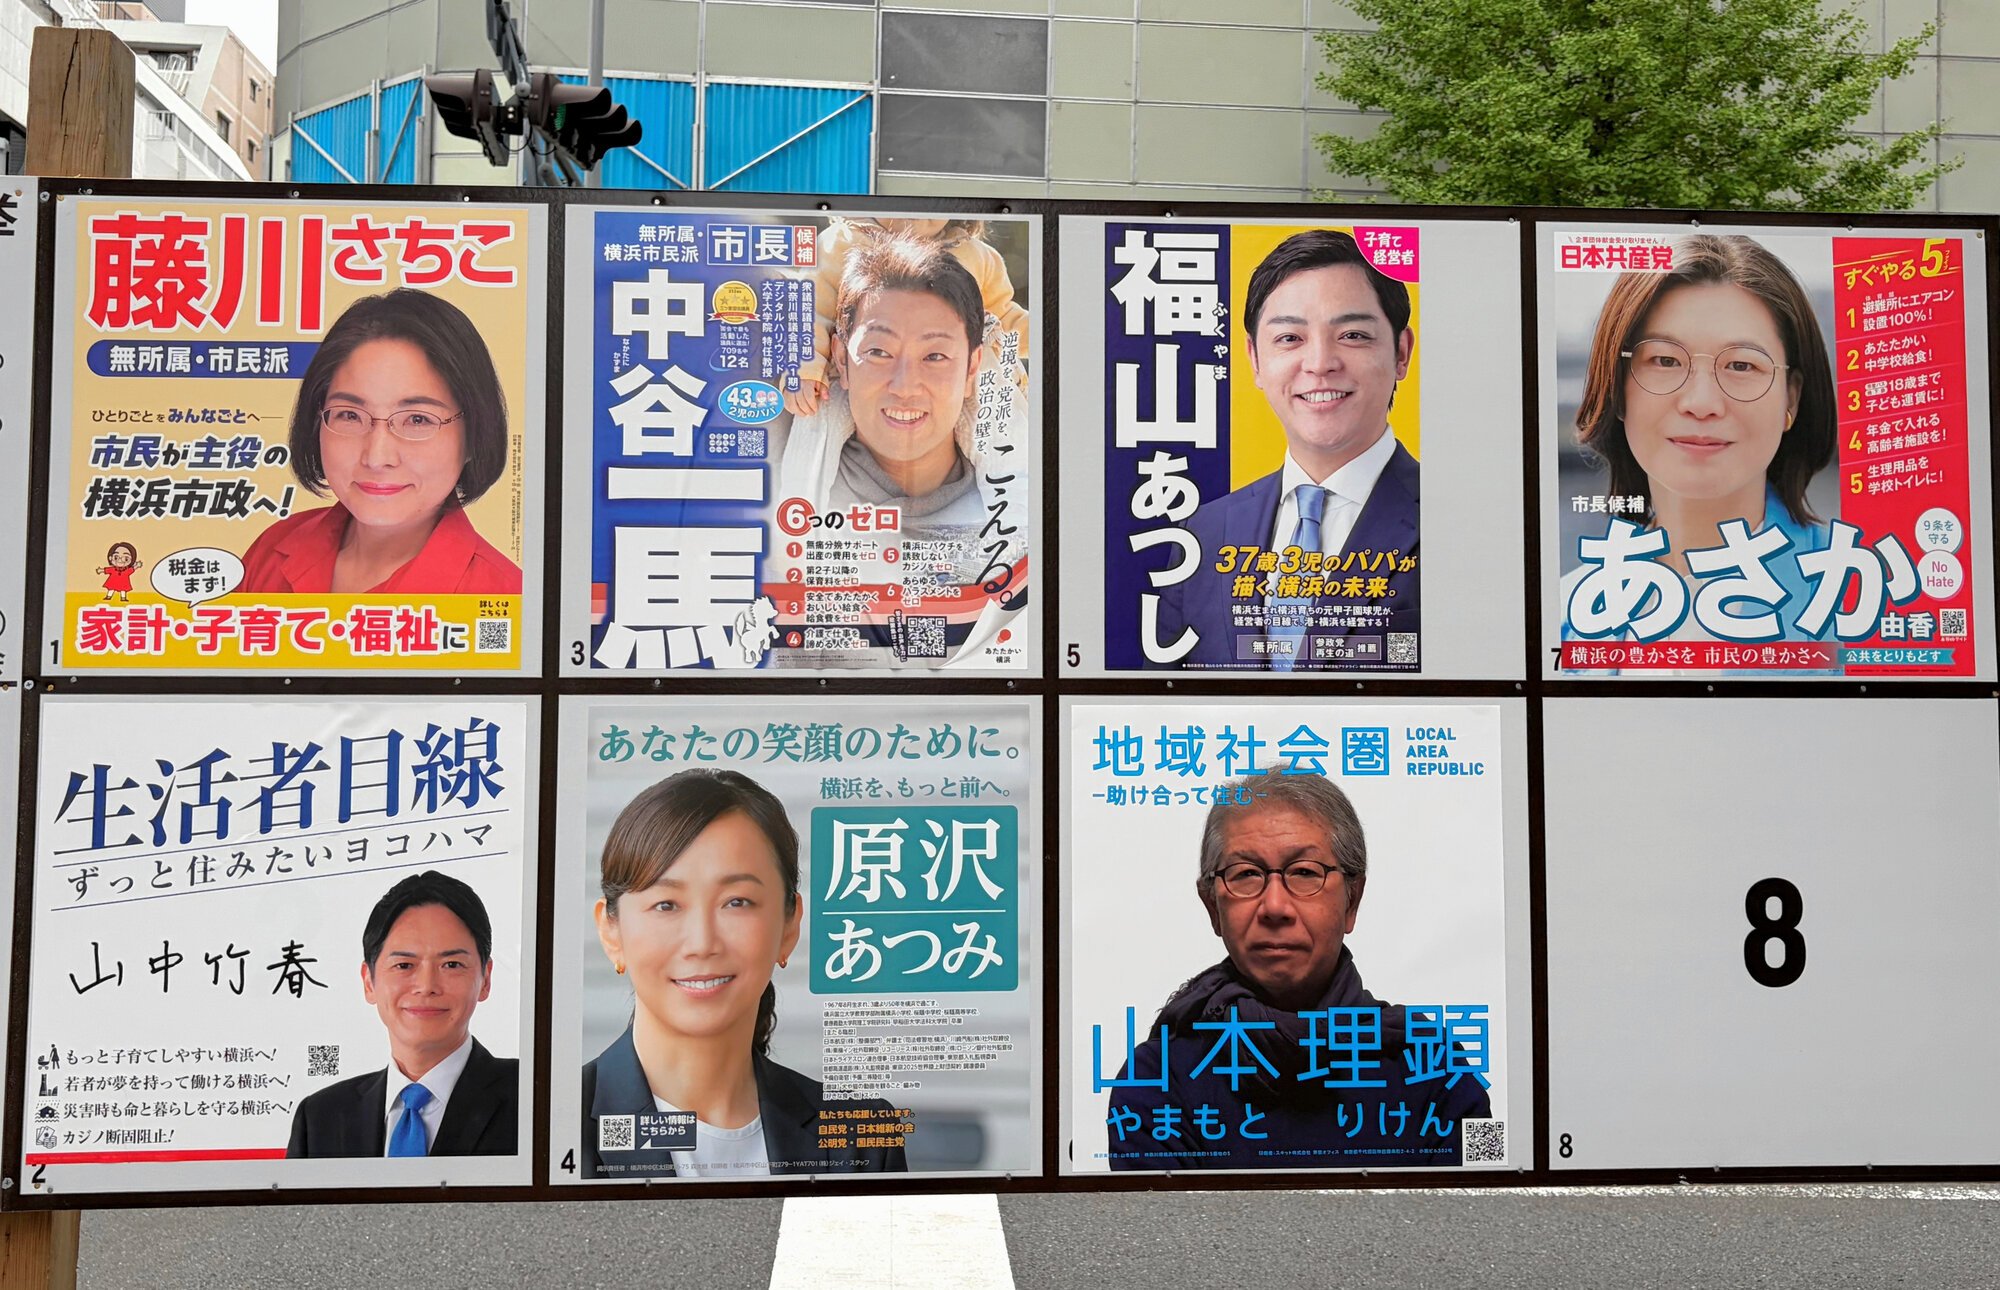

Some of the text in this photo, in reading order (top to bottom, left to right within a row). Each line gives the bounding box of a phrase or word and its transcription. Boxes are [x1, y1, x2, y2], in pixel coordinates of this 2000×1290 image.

[711, 227, 789, 263] 市長
[796, 228, 814, 264] 候補
[1363, 231, 1403, 248] 子育て
[604, 243, 700, 263] 横浜市民派
[1372, 249, 1416, 266] 経営者
[1561, 244, 1674, 270] 日本共産党
[1862, 289, 1955, 316] 避難所にエアコン
[774, 281, 786, 376] デジタルハリウッド
[1846, 308, 1856, 329] 1
[1862, 308, 1933, 332] 設置100%!
[761, 281, 774, 378] 大学大学院 特任教授
[1211, 302, 1229, 381] ふくやま
[1864, 333, 1927, 356] あたたかい
[109, 345, 290, 375] 無所属・市民派
[613, 351, 622, 374] かずま
[622, 338, 631, 367] なかたに
[720, 355, 750, 369] 12名
[1846, 350, 1860, 371] 2
[1864, 349, 1933, 373] 中学校給食!
[1888, 372, 1942, 393] 18歳まで
[1847, 390, 1861, 411] 3
[1865, 387, 1945, 414] 子ども運賃に!
[1866, 413, 1941, 438] 年金で入れる
[1110, 229, 1220, 664] 福山あつし
[1848, 431, 1863, 451] 4
[1867, 429, 1947, 455] 高齢者施設を!
[89, 434, 288, 471] 市民が主役の
[592, 268, 764, 668] 中谷一馬
[1867, 456, 1929, 479] 生理用品を
[1850, 473, 1864, 494] 5
[1868, 470, 1944, 496] 学校トイレに!
[83, 478, 293, 520] 横浜市政へ!
[1571, 494, 1645, 514] 市長候補
[785, 502, 900, 532] 6つのゼロ
[1923, 519, 1954, 534] 9条を
[1927, 533, 1951, 547] 守る
[168, 557, 221, 576] 税金は
[806, 551, 877, 561] 出産の費用をゼロ
[902, 552, 948, 562] 誘致しない
[1214, 545, 1418, 573] 37歳3児のパパが
[806, 565, 859, 576] 第2子以降の
[902, 562, 953, 572] カジノをゼロ
[1931, 560, 1949, 574] No
[183, 576, 227, 594] まず!
[806, 576, 860, 587] 保育料をゼロ
[902, 577, 938, 586] あらゆる
[1231, 575, 1398, 599] 描く、横浜の未来。
[1567, 517, 1935, 642] あさか 由香
[1926, 575, 1956, 589] Hate
[806, 592, 879, 602] 安全であたたかく
[806, 603, 871, 612] おいしい給食へ
[903, 597, 921, 607] ゼロ
[806, 613, 860, 623] 給食費をゼロ
[79, 606, 469, 656] 家計・子育て・福祉に
[806, 628, 859, 639] 介護で仕事を
[50, 639, 60, 665] 1
[985, 647, 1022, 655] あたたかい
[1251, 640, 1294, 654] 無所属
[1315, 637, 1346, 647] 参政党
[1357, 642, 1378, 654] 推薦
[571, 640, 585, 666] 3
[996, 655, 1012, 664] 横浜
[1066, 642, 1081, 668] 5
[1315, 648, 1355, 658] 再生の道
[1550, 648, 1562, 672] 7
[1569, 647, 1831, 666] 横浜の豊かさを 市民の豊かさへ
[1845, 649, 1942, 664] 公共をとりもどす
[598, 722, 1019, 764] あなたの笑顔のために。
[1406, 727, 1457, 741] LOCAL
[1092, 724, 1390, 777] 地域社会圏
[1406, 744, 1450, 759] AREA
[1406, 761, 1485, 776] REPUBLIC
[53, 716, 507, 856] 生活者目線
[819, 777, 1010, 799] 横浜を、もっと前へ。
[67, 822, 494, 902] ずっと住みたいヨコハマ
[823, 817, 1005, 904] 原沢
[1743, 876, 1807, 988] 8
[824, 919, 1004, 983] あつみ
[69, 940, 330, 999] 山中竹春
[65, 1047, 278, 1066] もっと子育てしやすい横浜へ!
[1092, 1003, 1492, 1094] 山本理顕
[64, 1072, 291, 1092] 若者が夢を持って働ける横浜へ!
[63, 1099, 293, 1119] 災害時も命と暮らしを守る横浜へ!
[819, 1108, 916, 1120] 私たちも応援しています。
[640, 1114, 696, 1126] 詳しい情報は
[818, 1123, 915, 1135] 自民党・日本維新の会
[1105, 1101, 1455, 1141] やまもと りけん
[63, 1128, 176, 1147] カジノ断固阻止!
[640, 1126, 687, 1137] こちらから
[818, 1137, 905, 1149] 公明党・国民民主党
[1558, 1132, 1573, 1159] 8
[561, 1148, 576, 1174] 4
[31, 1164, 46, 1183] 2
